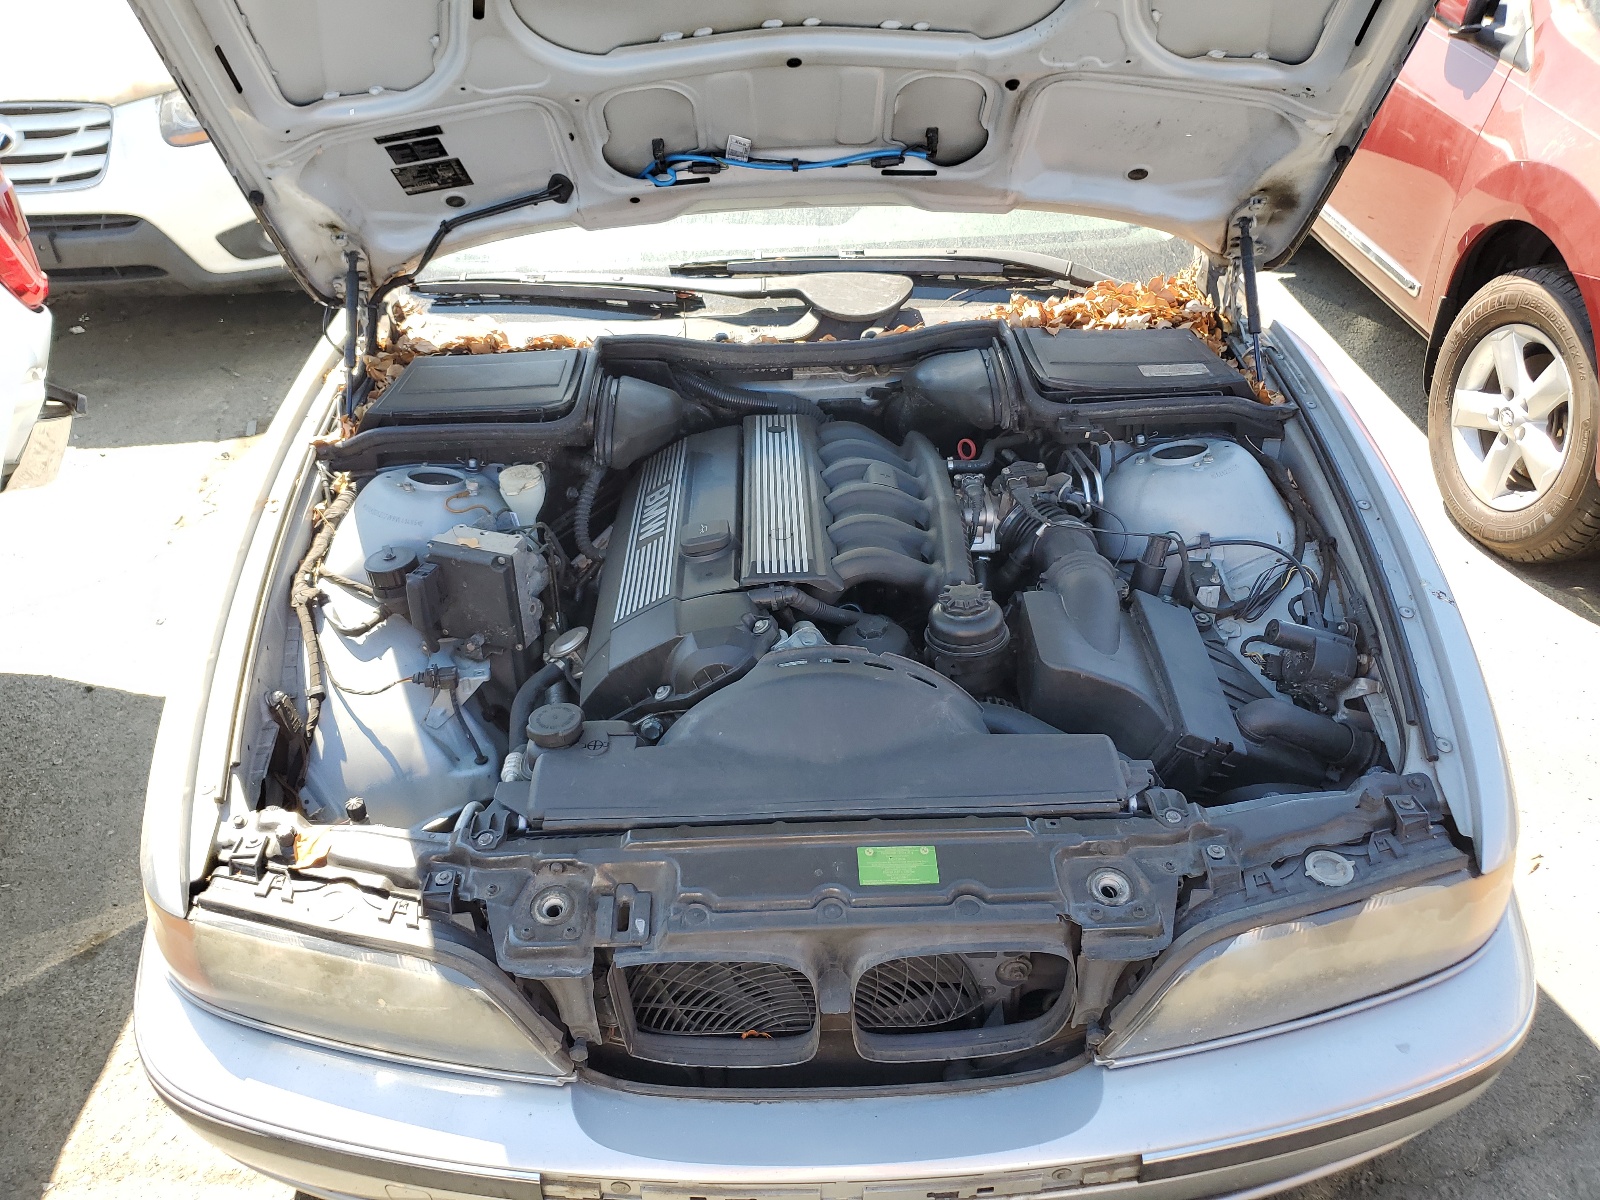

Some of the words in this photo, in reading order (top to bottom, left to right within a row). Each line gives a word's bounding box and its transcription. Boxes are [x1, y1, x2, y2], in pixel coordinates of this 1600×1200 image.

[1461, 293, 1519, 329] MICHELIN
[1523, 293, 1566, 334] DEFENDER
[1565, 335, 1581, 361] LTX
[639, 483, 671, 541] BMW
